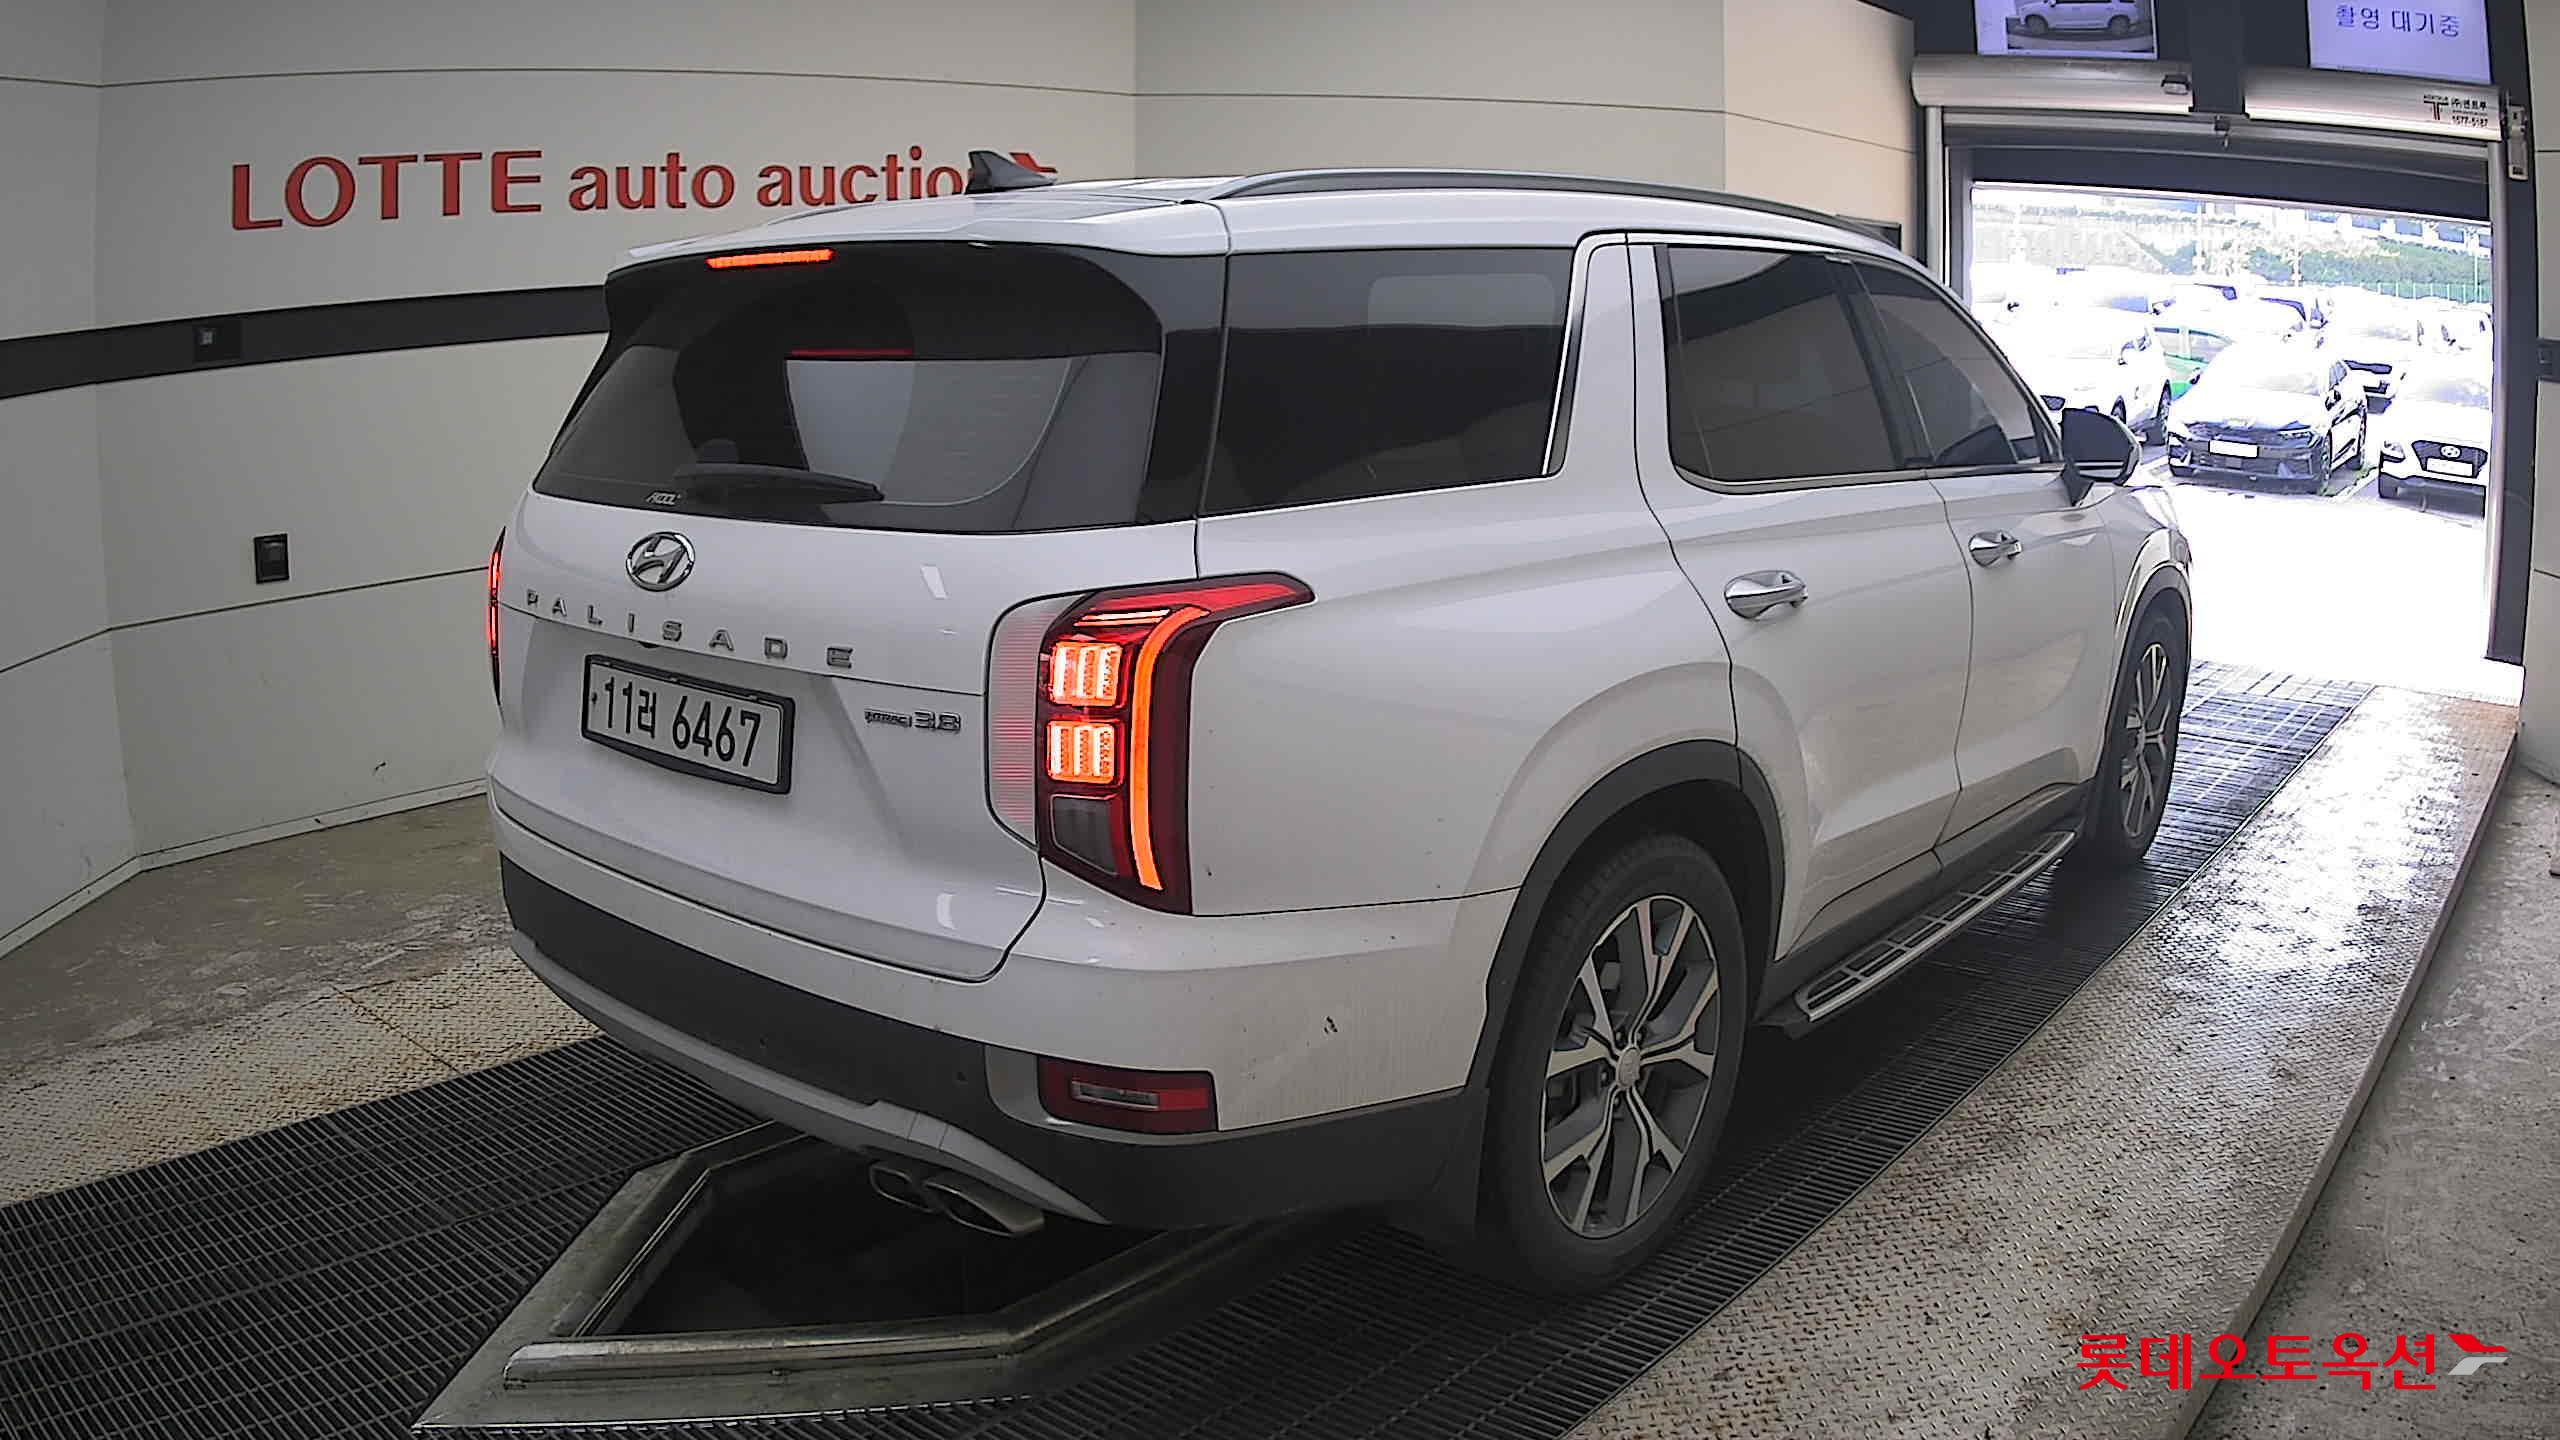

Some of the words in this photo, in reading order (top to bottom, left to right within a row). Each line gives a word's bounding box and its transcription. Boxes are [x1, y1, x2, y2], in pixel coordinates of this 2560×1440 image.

[2336, 5, 2380, 30] 촬영
[2391, 10, 2460, 38] 대기중
[231, 149, 542, 231] LOTTE
[568, 152, 736, 211] auto
[756, 145, 972, 207] auctio
[526, 588, 854, 669] PALISADE
[604, 676, 658, 739] 11러
[672, 695, 762, 768] 6467
